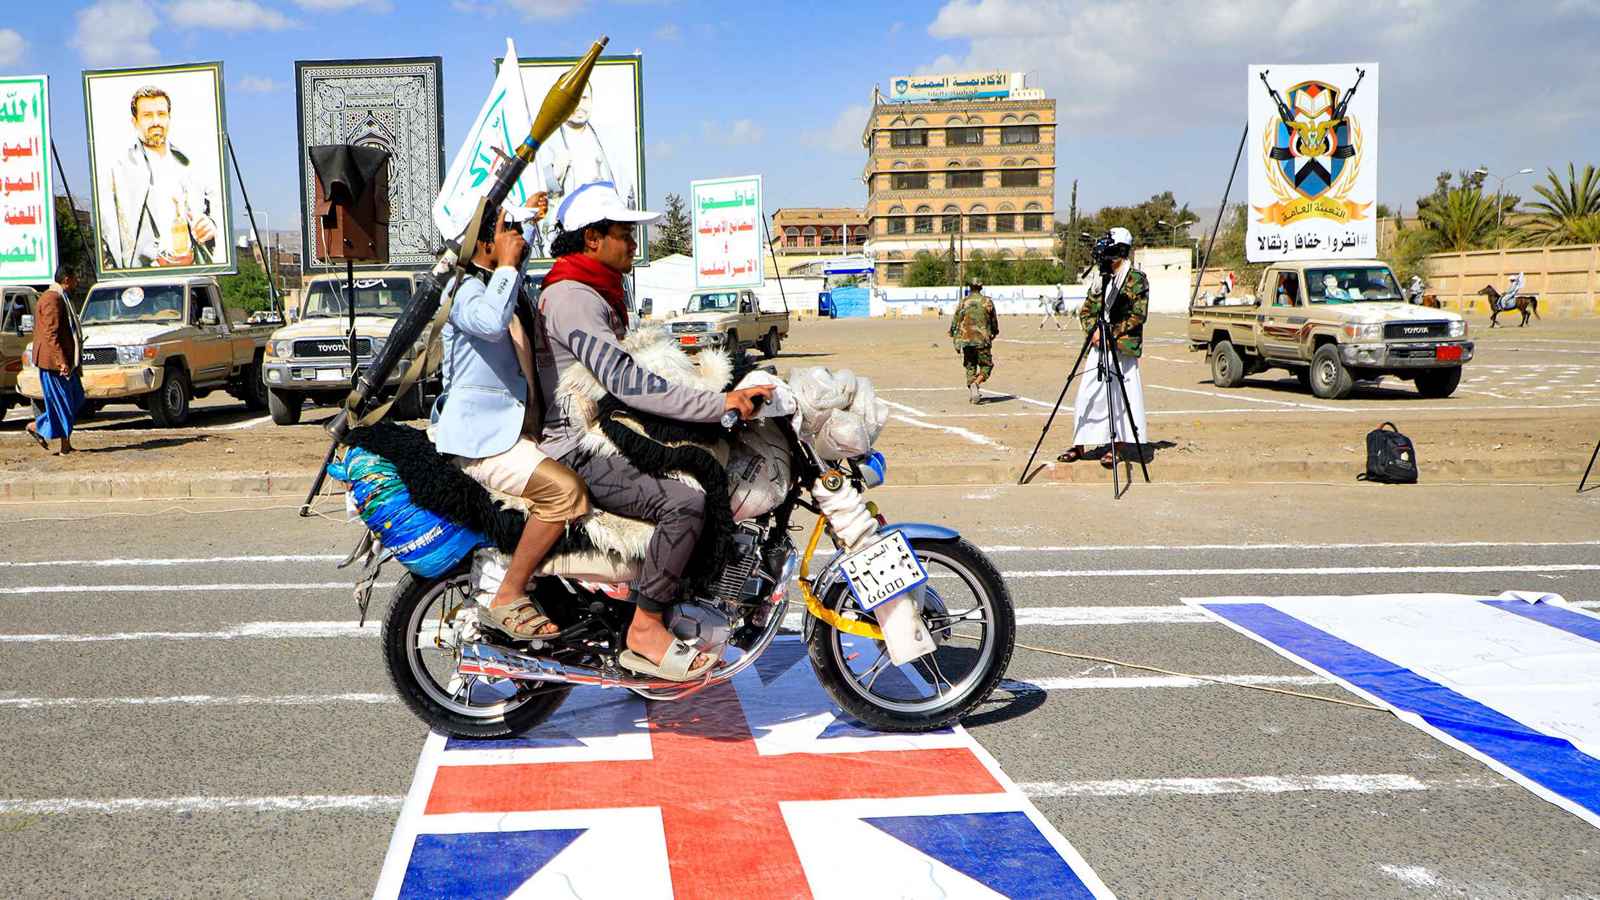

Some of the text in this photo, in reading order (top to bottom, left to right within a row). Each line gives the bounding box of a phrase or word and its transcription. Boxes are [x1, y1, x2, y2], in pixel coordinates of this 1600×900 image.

[0, 137, 39, 162] المو
[1403, 327, 1429, 335] TOYOTA
[317, 344, 347, 352] TOYOTA
[82, 353, 96, 361] OTA
